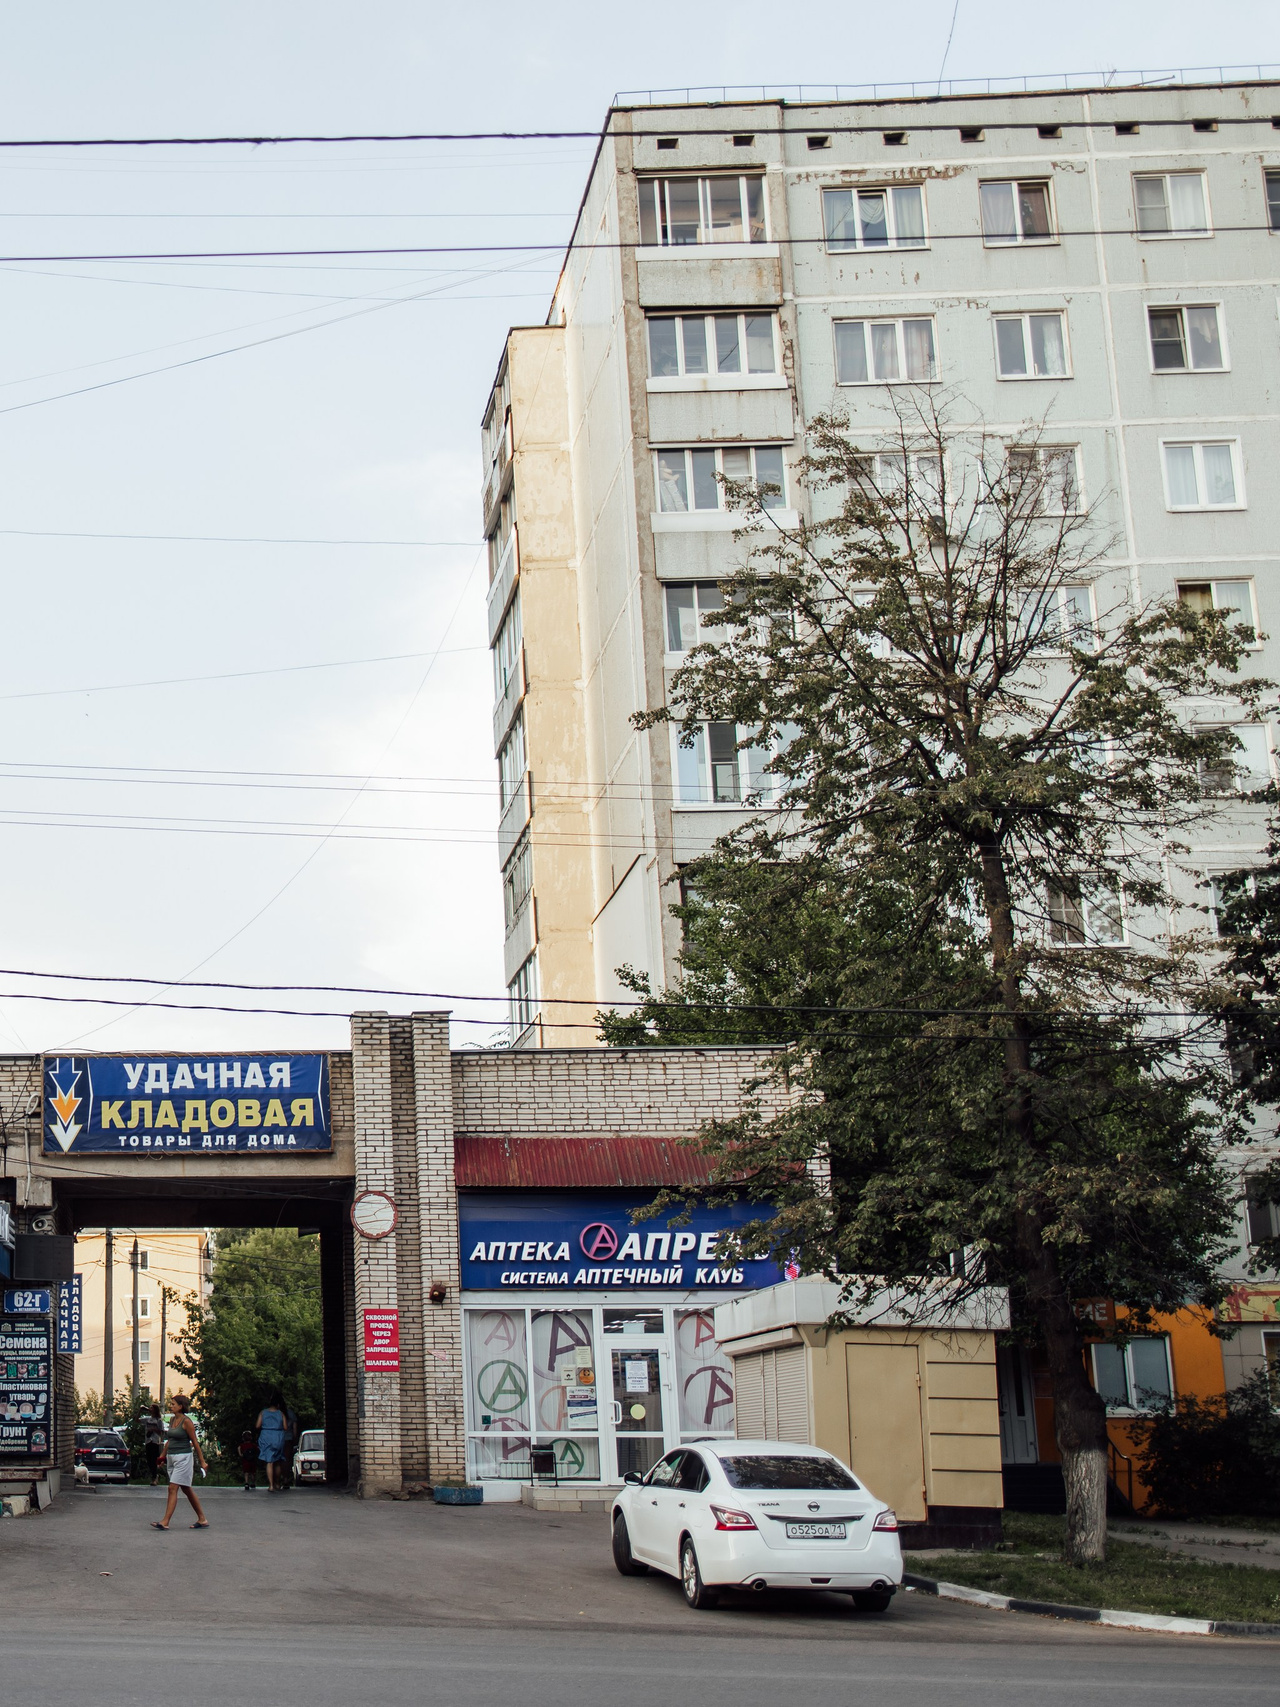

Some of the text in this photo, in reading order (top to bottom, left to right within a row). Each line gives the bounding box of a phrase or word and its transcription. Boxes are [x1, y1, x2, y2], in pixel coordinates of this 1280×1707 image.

[123, 1062, 291, 1094] УДАЧНАЯ
[101, 1098, 315, 1133] КЛАДОВАЯ
[119, 1134, 297, 1147] ТОВАРЫ ДЛЯ ДОМА
[469, 1241, 571, 1261] АПТЕКА
[501, 1265, 744, 1285] СИСТЕМА АПТЕЧНЫЙ КЛУБ
[60, 1281, 70, 1350] ДАЧНАЯ
[71, 1278, 80, 1350] КЛАДОВАЯ
[9, 1393, 36, 1401] утварь
